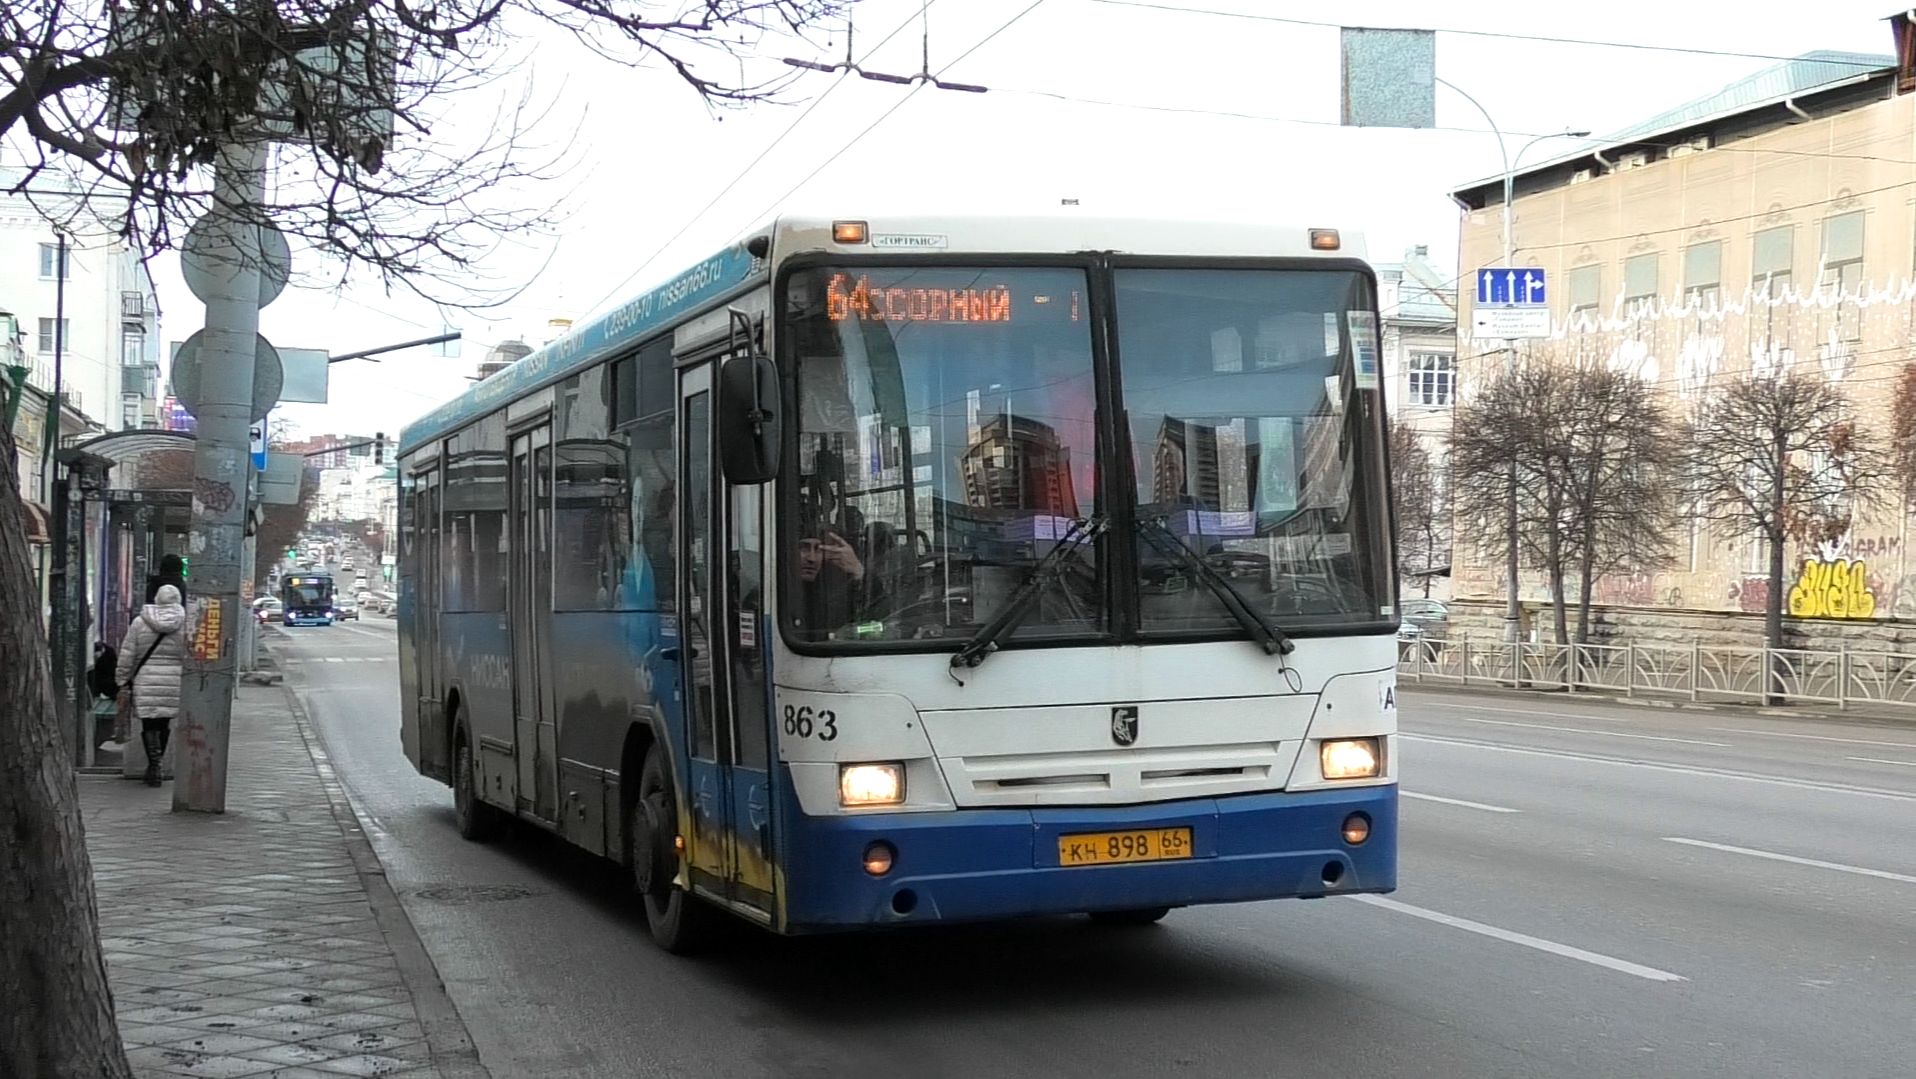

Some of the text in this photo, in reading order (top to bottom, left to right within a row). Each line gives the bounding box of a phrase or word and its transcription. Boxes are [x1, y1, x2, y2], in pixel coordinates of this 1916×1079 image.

[657, 258, 723, 312] nissan66.ru
[826, 272, 870, 321] 64
[206, 597, 221, 660] ДЕНЬГИ
[784, 704, 838, 742] 863
[1107, 834, 1149, 858] 898
[1161, 830, 1183, 849] 66
